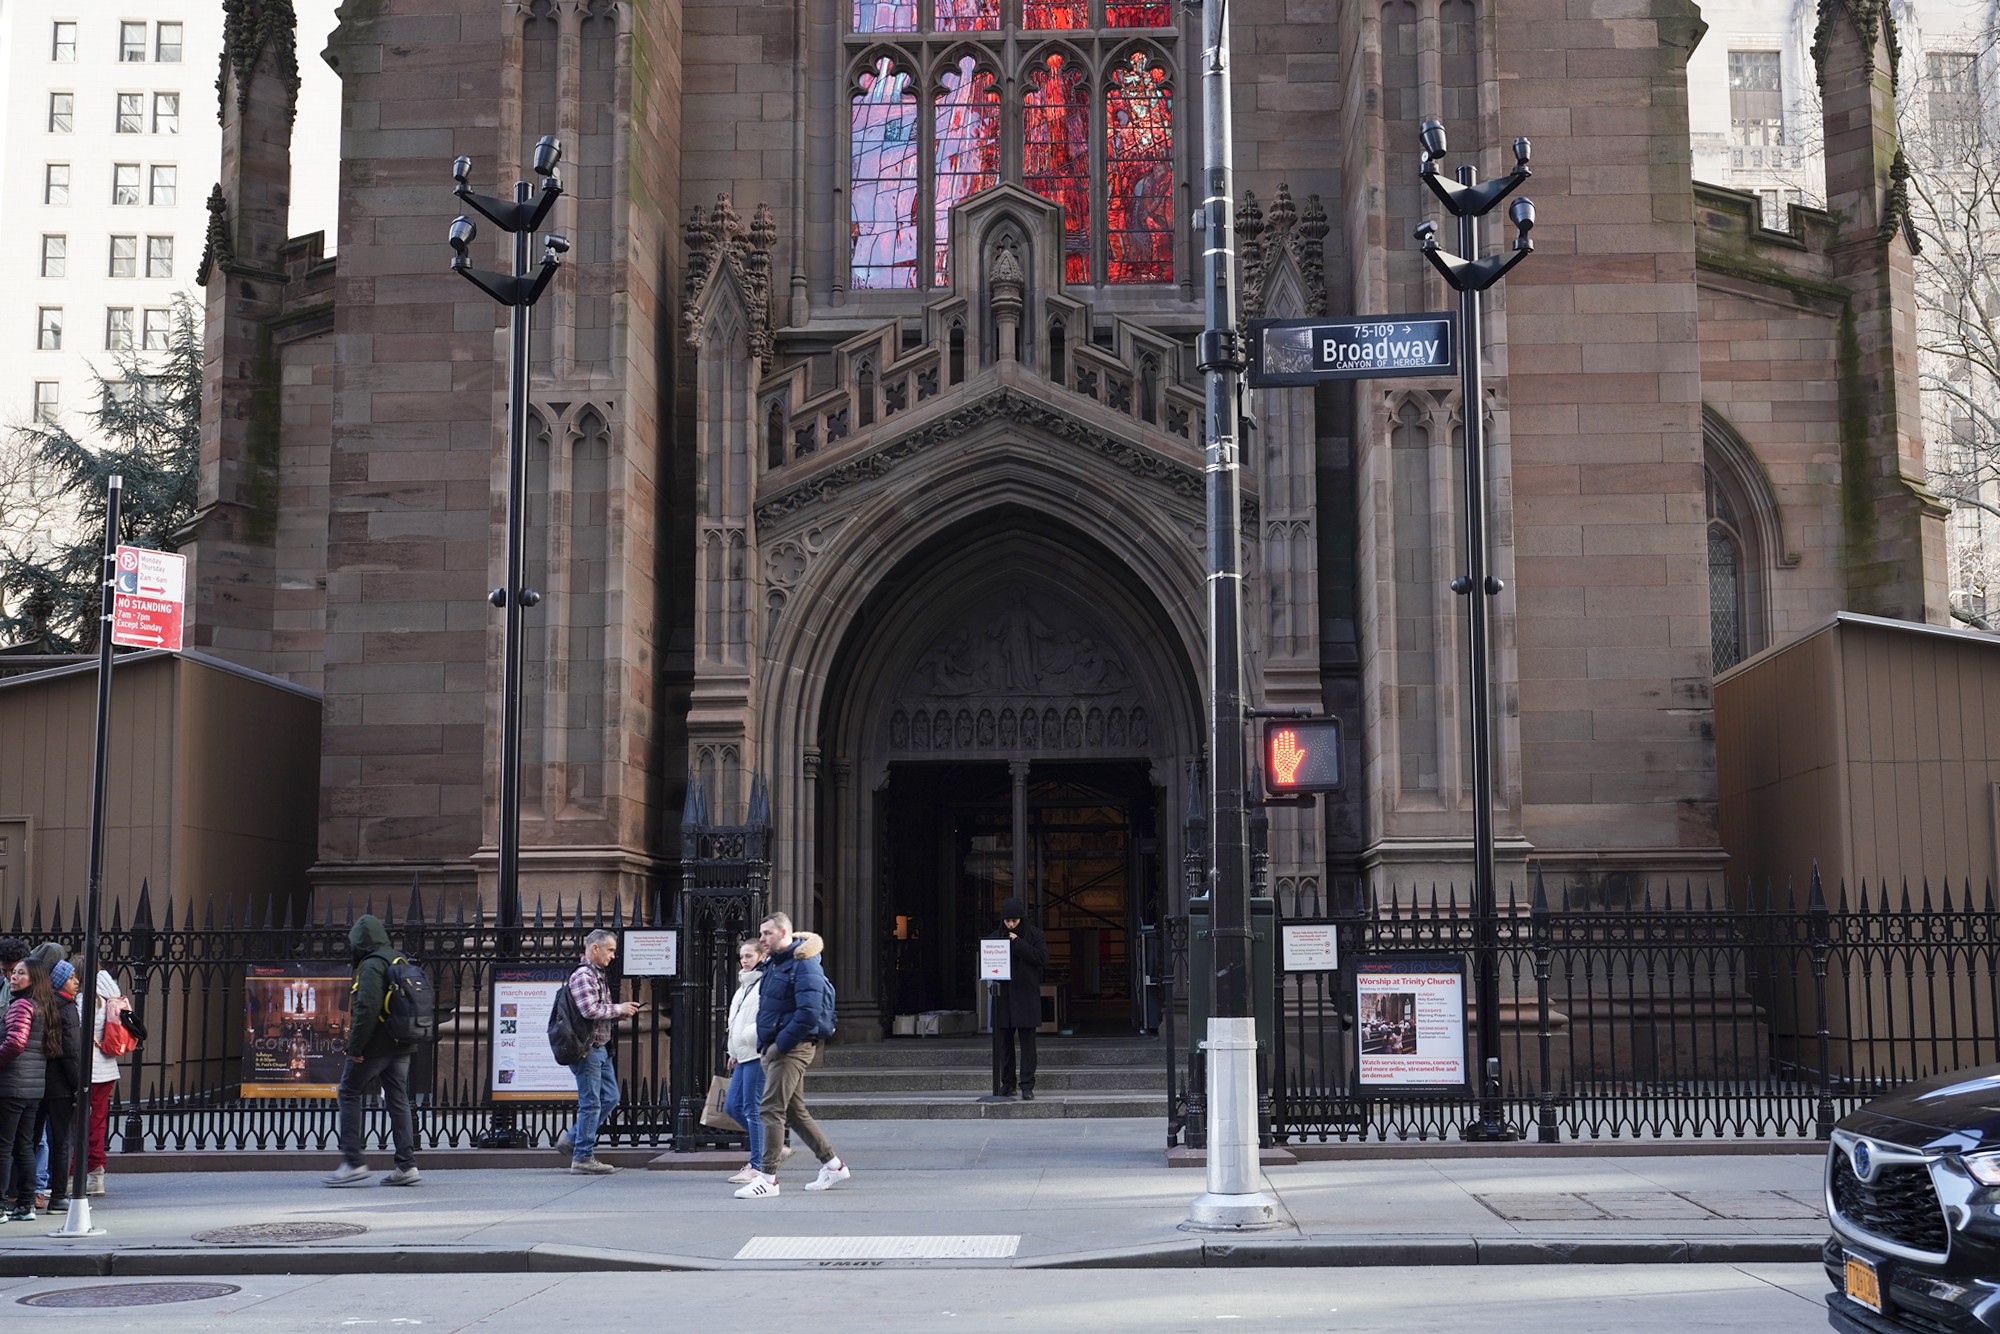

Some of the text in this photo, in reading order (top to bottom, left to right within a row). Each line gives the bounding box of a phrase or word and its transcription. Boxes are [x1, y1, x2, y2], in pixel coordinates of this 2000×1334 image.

[1354, 325, 1394, 338] 75-109
[1323, 338, 1439, 362] Broadway
[1336, 357, 1426, 369] CANYON OF HEROES
[142, 556, 162, 565] Monday
[141, 563, 166, 573] Thursday
[118, 598, 172, 613] NO STANDING
[137, 611, 150, 620] 7pm
[117, 619, 162, 633] Except Sunday
[1401, 978, 1425, 986] Trinity
